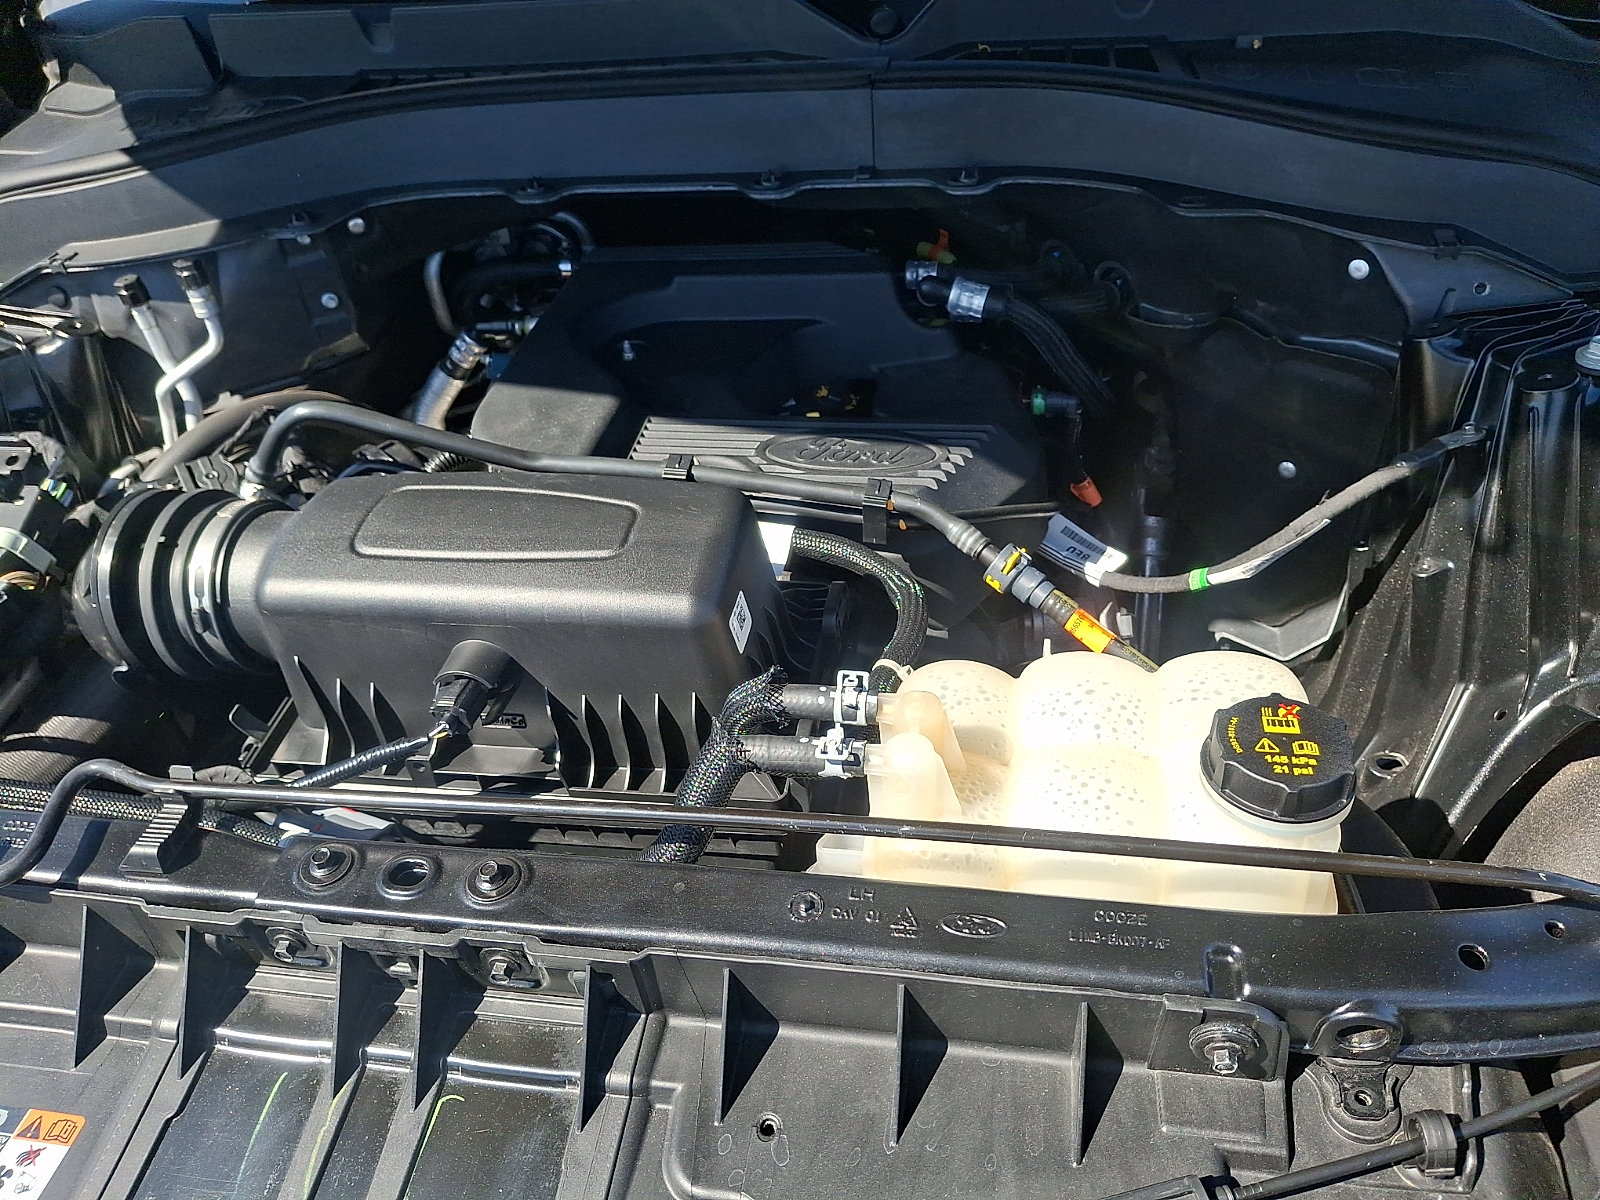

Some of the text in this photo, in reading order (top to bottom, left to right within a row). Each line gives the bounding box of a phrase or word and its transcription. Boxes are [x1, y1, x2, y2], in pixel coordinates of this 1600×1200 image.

[794, 437, 911, 465] Ford
[1264, 754, 1319, 766] 145 kPa
[1273, 765, 1315, 776] 21 psi
[848, 886, 876, 903] LH
